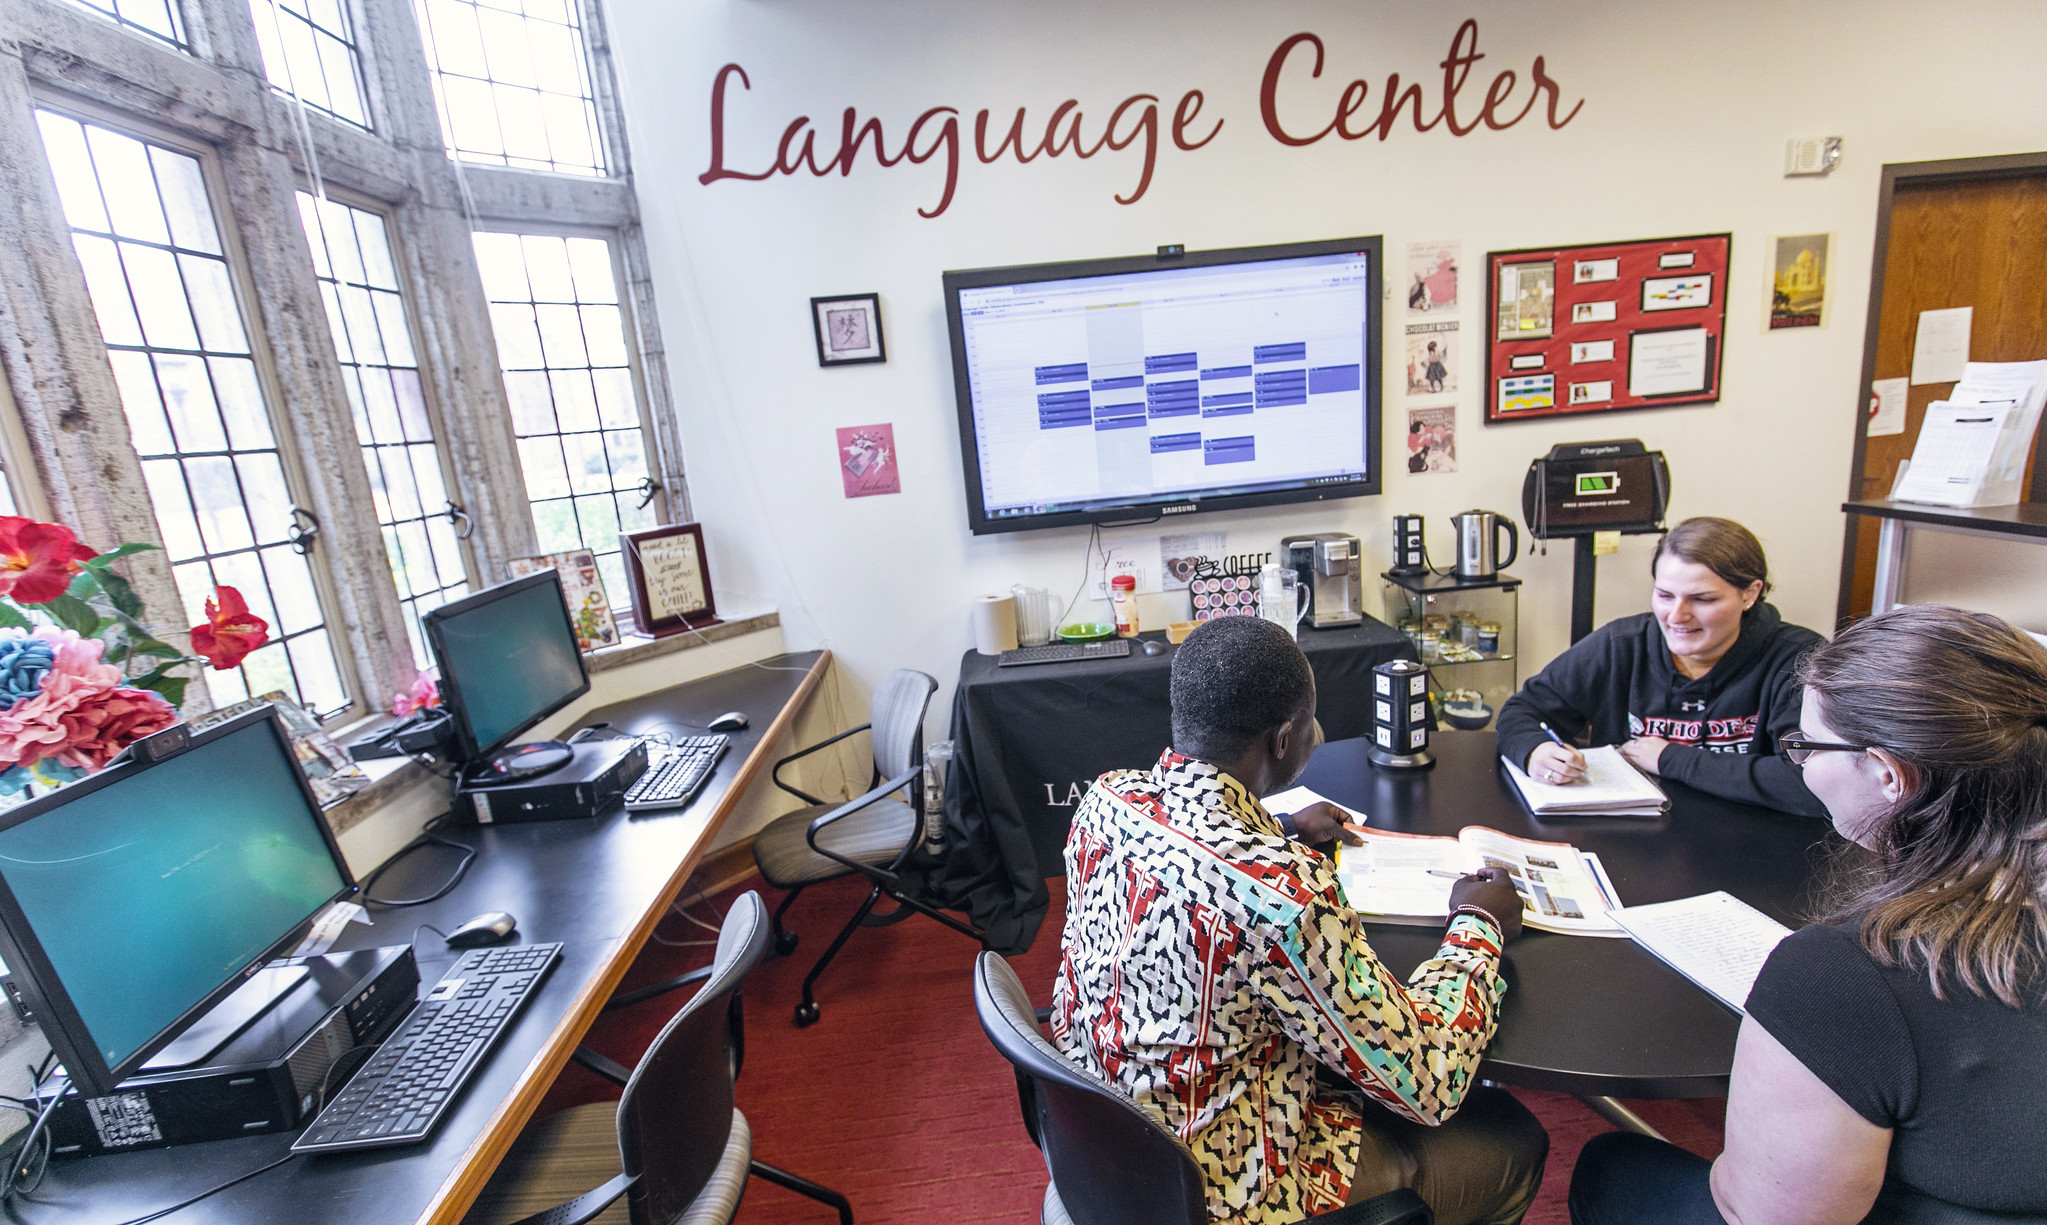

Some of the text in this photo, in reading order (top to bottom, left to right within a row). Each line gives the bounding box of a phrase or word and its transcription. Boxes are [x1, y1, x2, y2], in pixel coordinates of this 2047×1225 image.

[698, 18, 1585, 218] Language Center
[1162, 504, 1197, 514] SAMSUNG
[1645, 715, 1760, 741] RHODES
